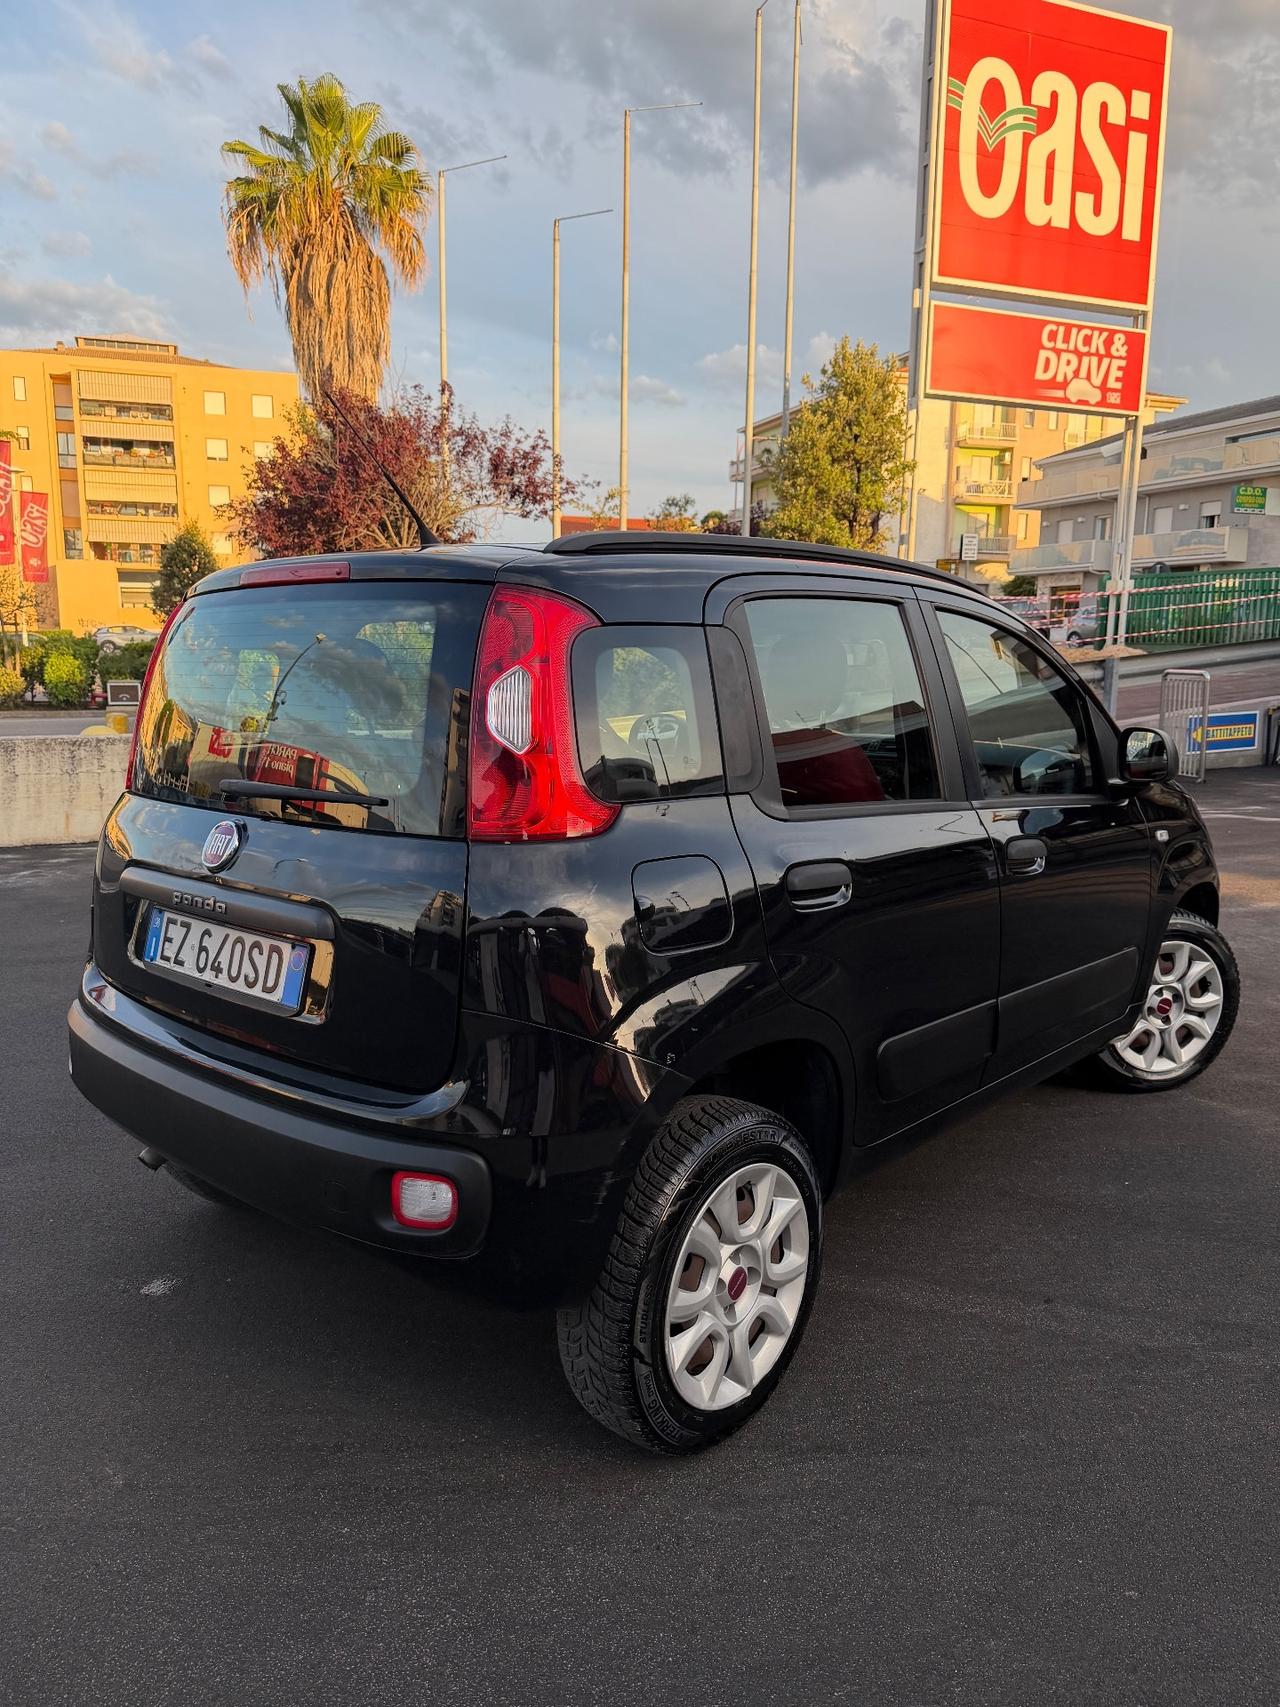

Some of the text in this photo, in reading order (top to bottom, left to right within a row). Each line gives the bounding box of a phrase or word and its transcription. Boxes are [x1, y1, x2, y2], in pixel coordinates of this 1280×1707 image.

[959, 56, 1150, 242] Oasi
[1041, 323, 1128, 357] CLICK &
[1034, 349, 1127, 389] DRIVE
[209, 834, 232, 856] FIAT
[172, 891, 227, 914] panda
[159, 917, 192, 967] EZ
